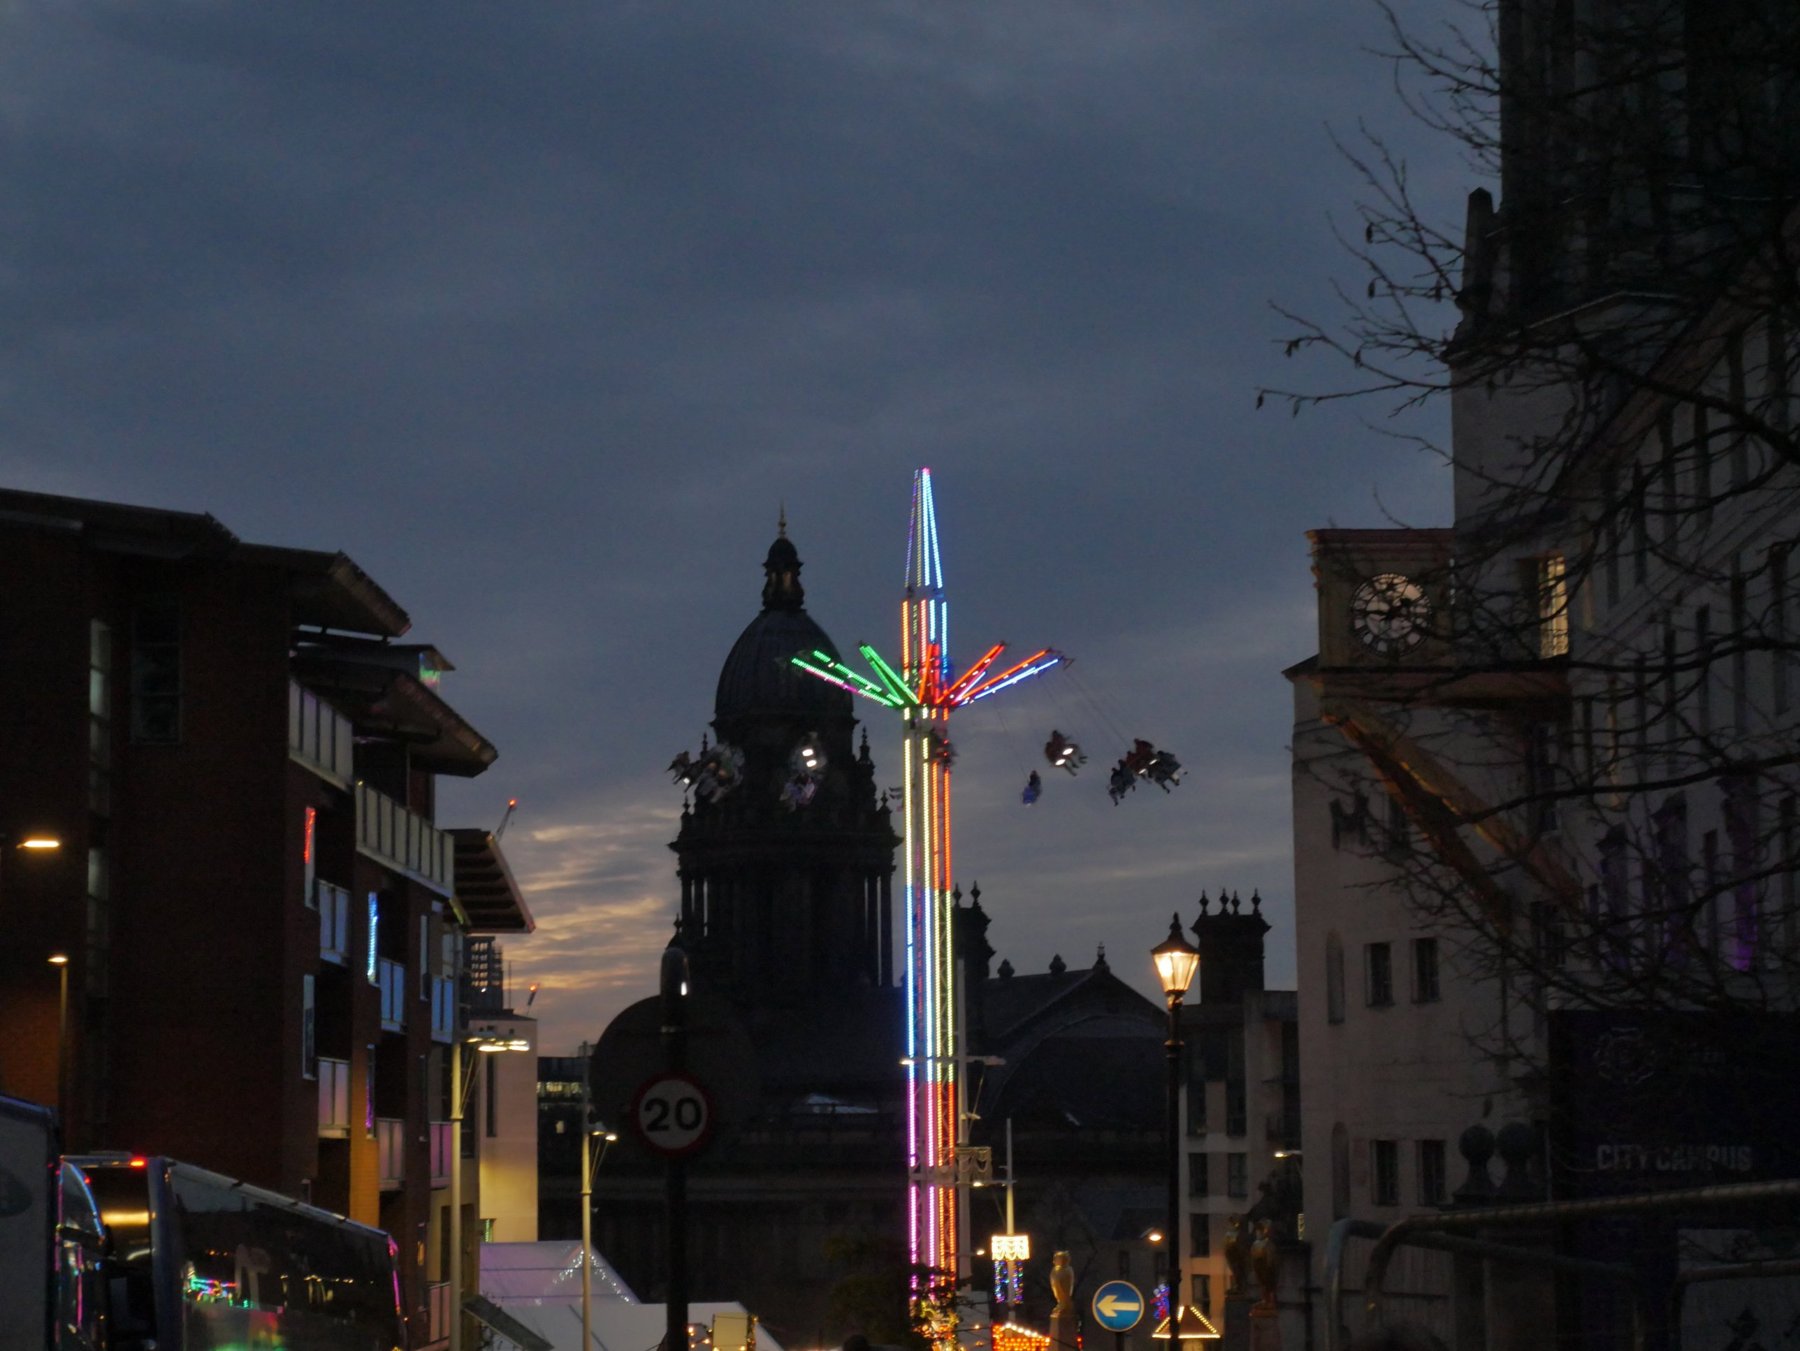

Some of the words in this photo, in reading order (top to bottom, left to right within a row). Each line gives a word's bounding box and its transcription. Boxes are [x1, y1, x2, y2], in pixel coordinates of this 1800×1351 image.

[645, 1097, 701, 1131] 20
[1597, 1144, 1648, 1171] CITY
[1655, 1143, 1753, 1172] CAMPUS
